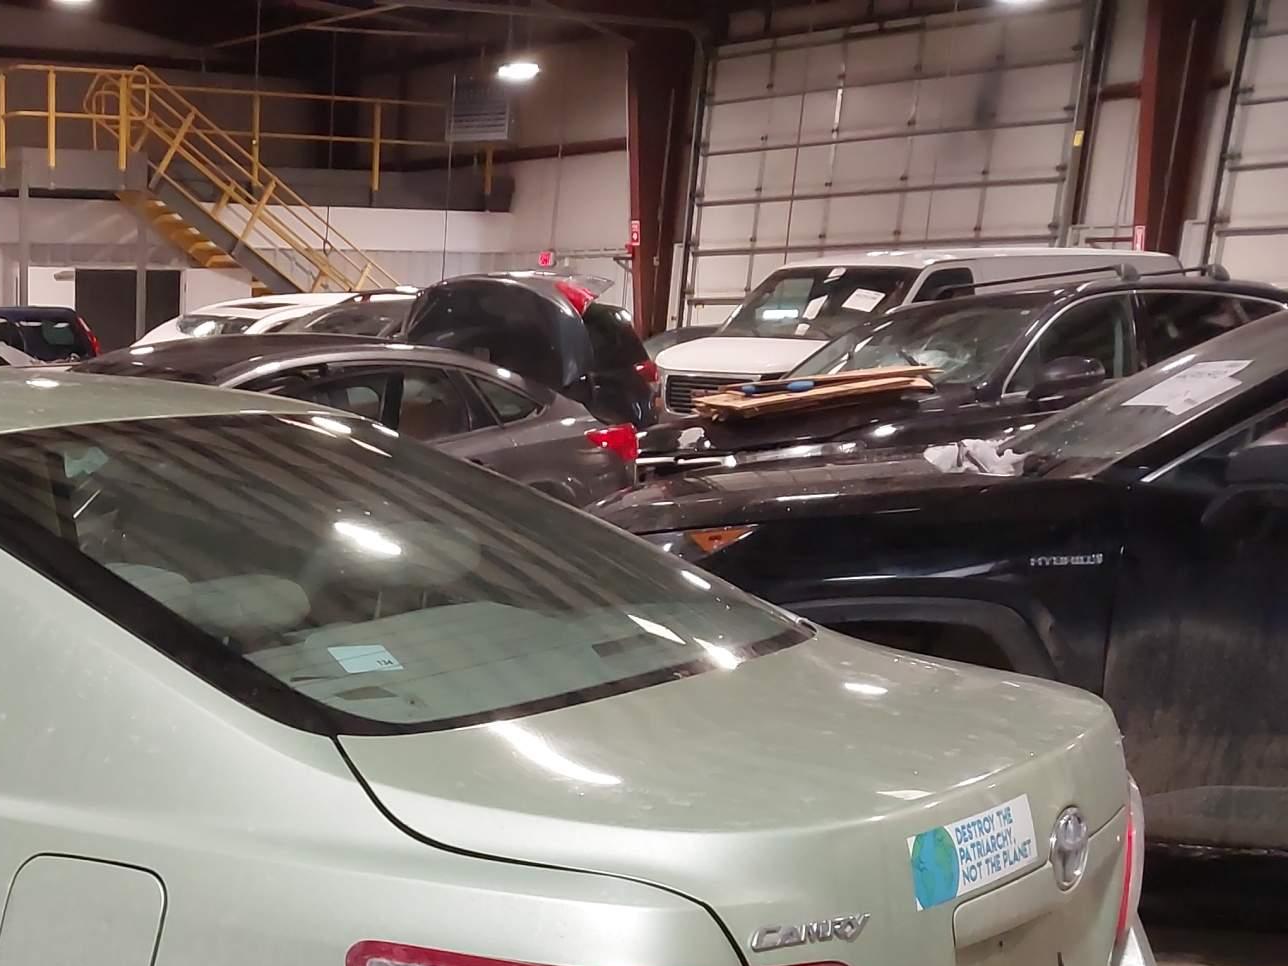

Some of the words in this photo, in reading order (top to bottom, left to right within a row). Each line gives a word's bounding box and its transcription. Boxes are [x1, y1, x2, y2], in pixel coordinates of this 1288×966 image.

[955, 813, 996, 845] DESTROY
[996, 806, 1014, 826] THE
[962, 862, 983, 887] NOT
[984, 852, 1002, 876] THE
[1002, 838, 1032, 868] PLANET
[749, 912, 871, 952] CAMRY
